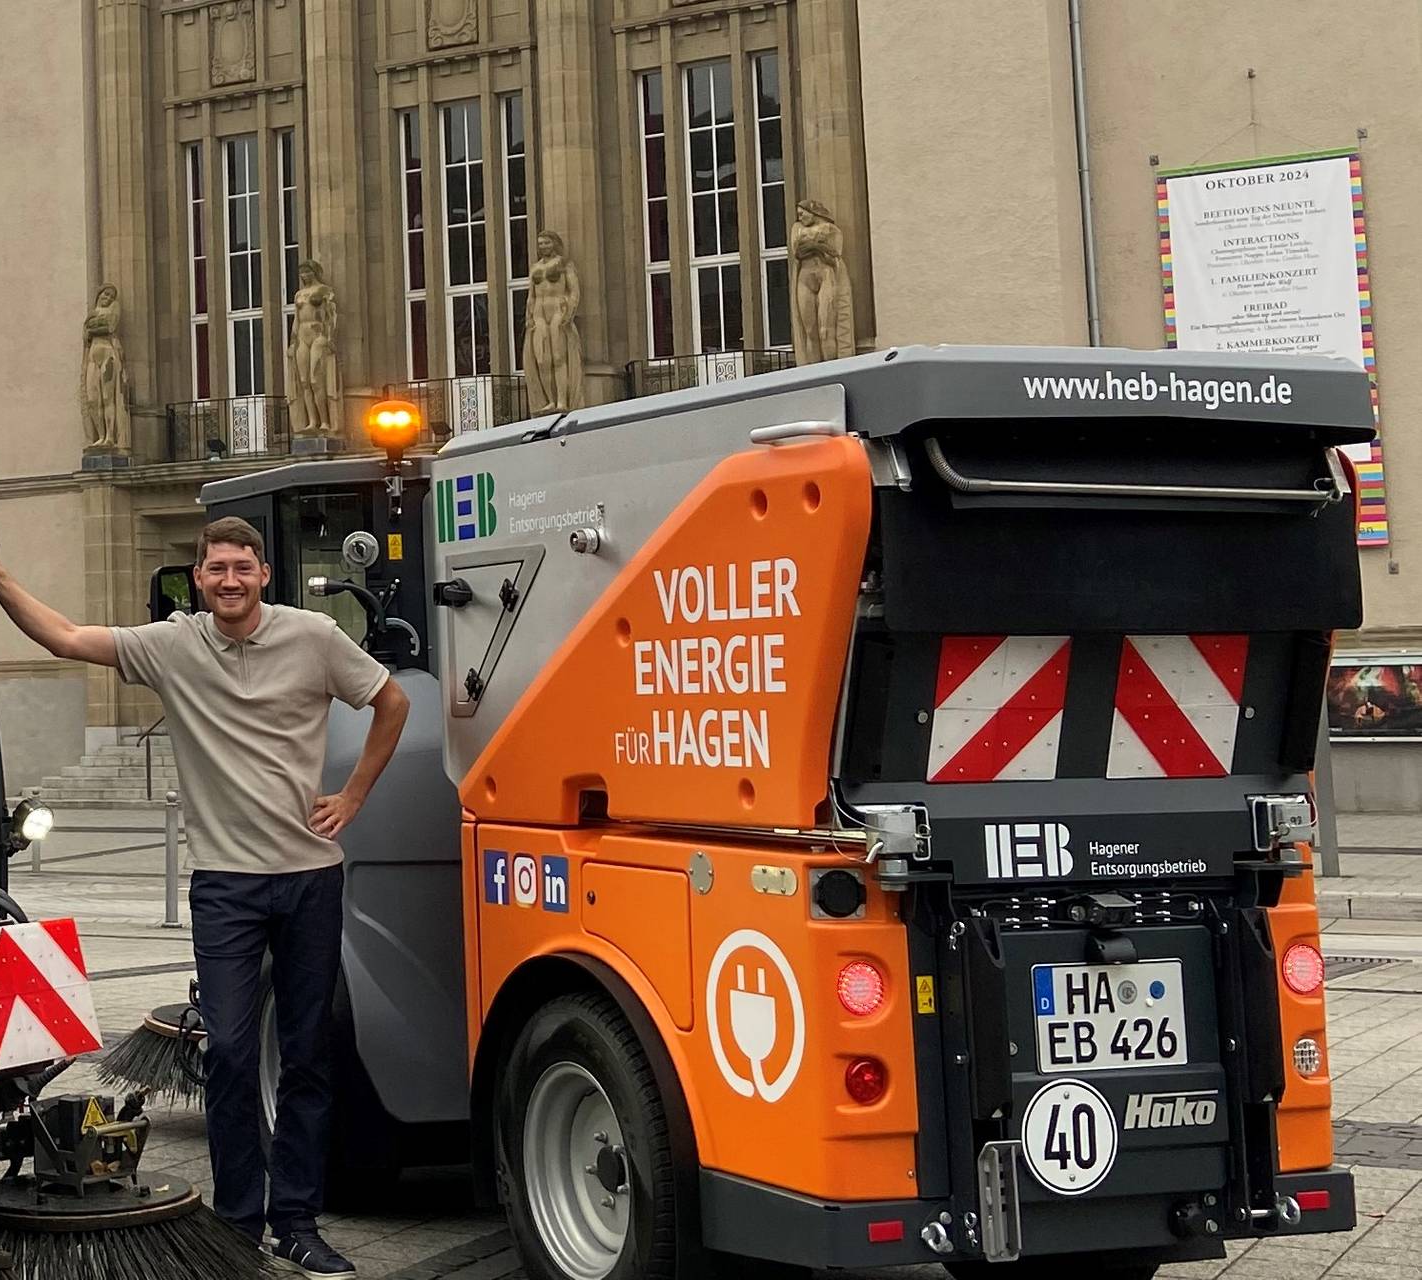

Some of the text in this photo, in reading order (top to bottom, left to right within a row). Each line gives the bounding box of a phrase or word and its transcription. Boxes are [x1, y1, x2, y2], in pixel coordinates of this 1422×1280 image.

[1205, 169, 1309, 190] OKTOBER 2024
[1203, 200, 1315, 219] BEETHOVENS NEUNTE
[1223, 232, 1300, 247] INTERACTIONS
[1220, 268, 1318, 285] FAMILIENKONZERT
[1243, 301, 1288, 312] FREIBAD
[1226, 335, 1321, 350] KAMMERKONZERT
[1023, 371, 1292, 410] www.heb-hagen.de
[509, 489, 547, 511] Hagener
[653, 557, 802, 624] VOLLER
[634, 634, 787, 695] ENERGIE
[614, 709, 770, 769] FÜR HAGEN
[1089, 841, 1140, 857] Hagener
[1091, 859, 1207, 878] Entsorgungsbetrieb
[1040, 971, 1115, 1015] D HA
[1048, 1017, 1178, 1065] EB 426
[1124, 1092, 1218, 1130] Hako
[1044, 1103, 1097, 1170] 40
